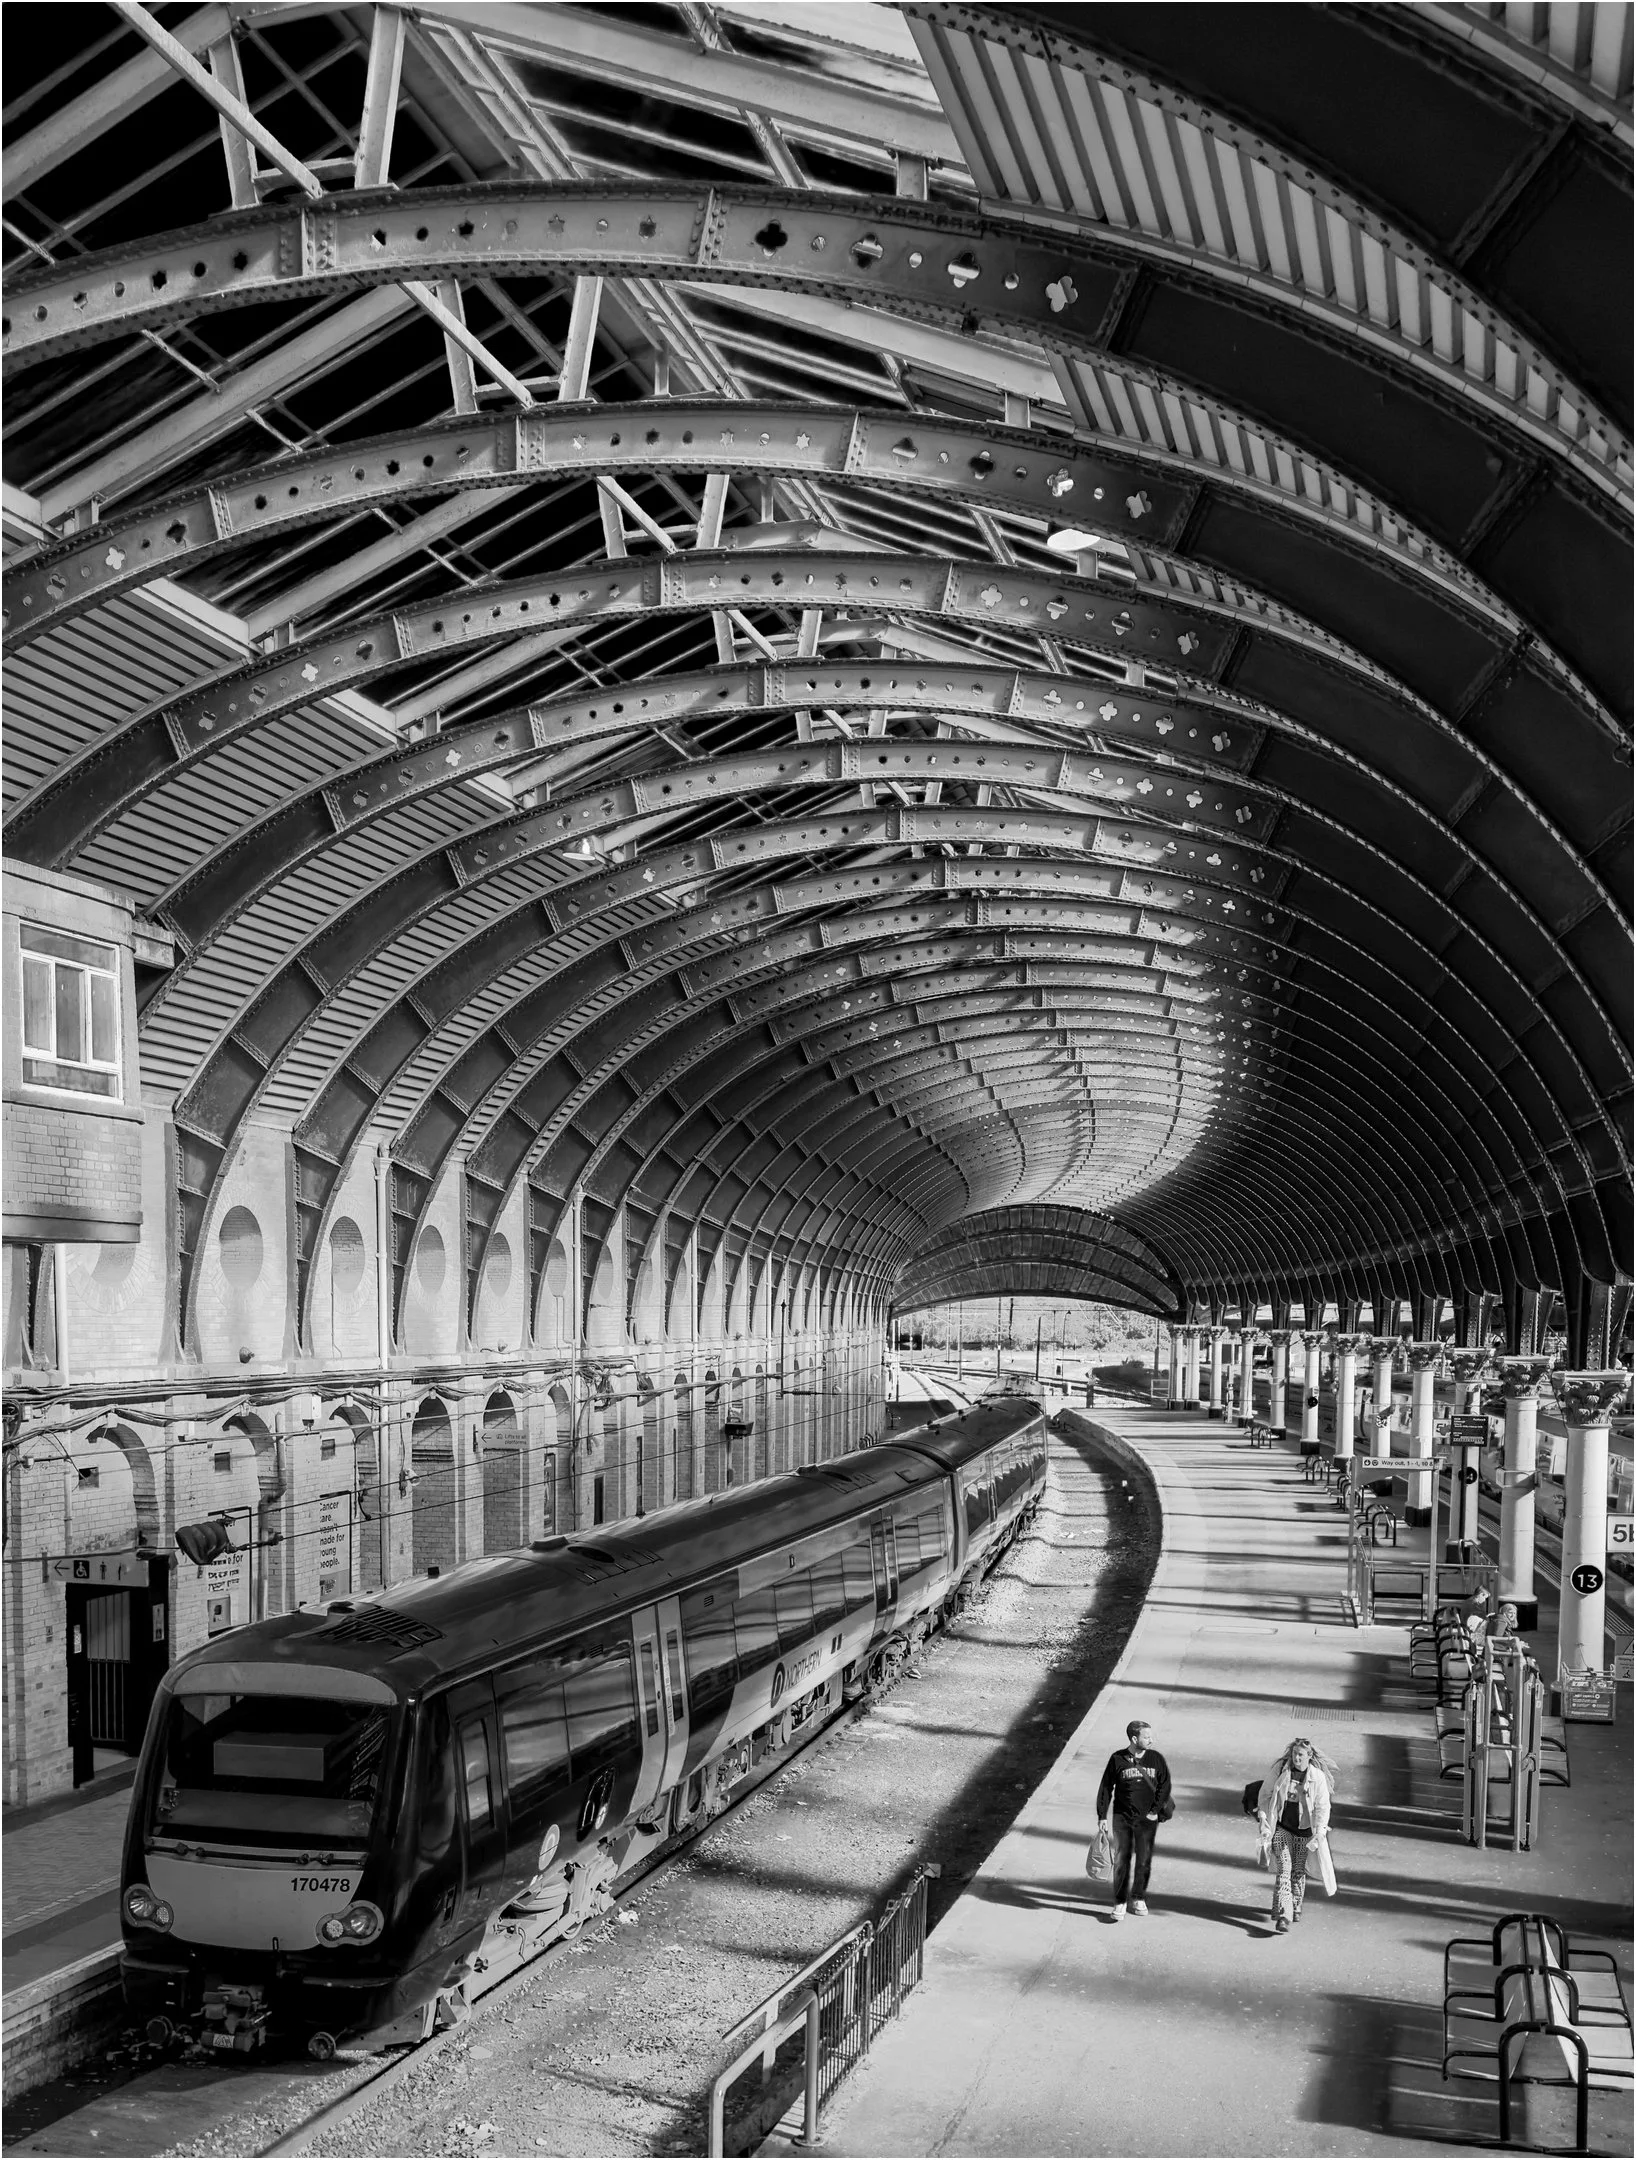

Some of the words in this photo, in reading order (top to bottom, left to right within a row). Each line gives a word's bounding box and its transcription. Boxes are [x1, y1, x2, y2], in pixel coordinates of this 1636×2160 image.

[336, 1533, 345, 1542] for
[1577, 1573, 1597, 1589] 13
[784, 1648, 822, 1692] NORTHERN
[291, 1877, 350, 1892] 170478
